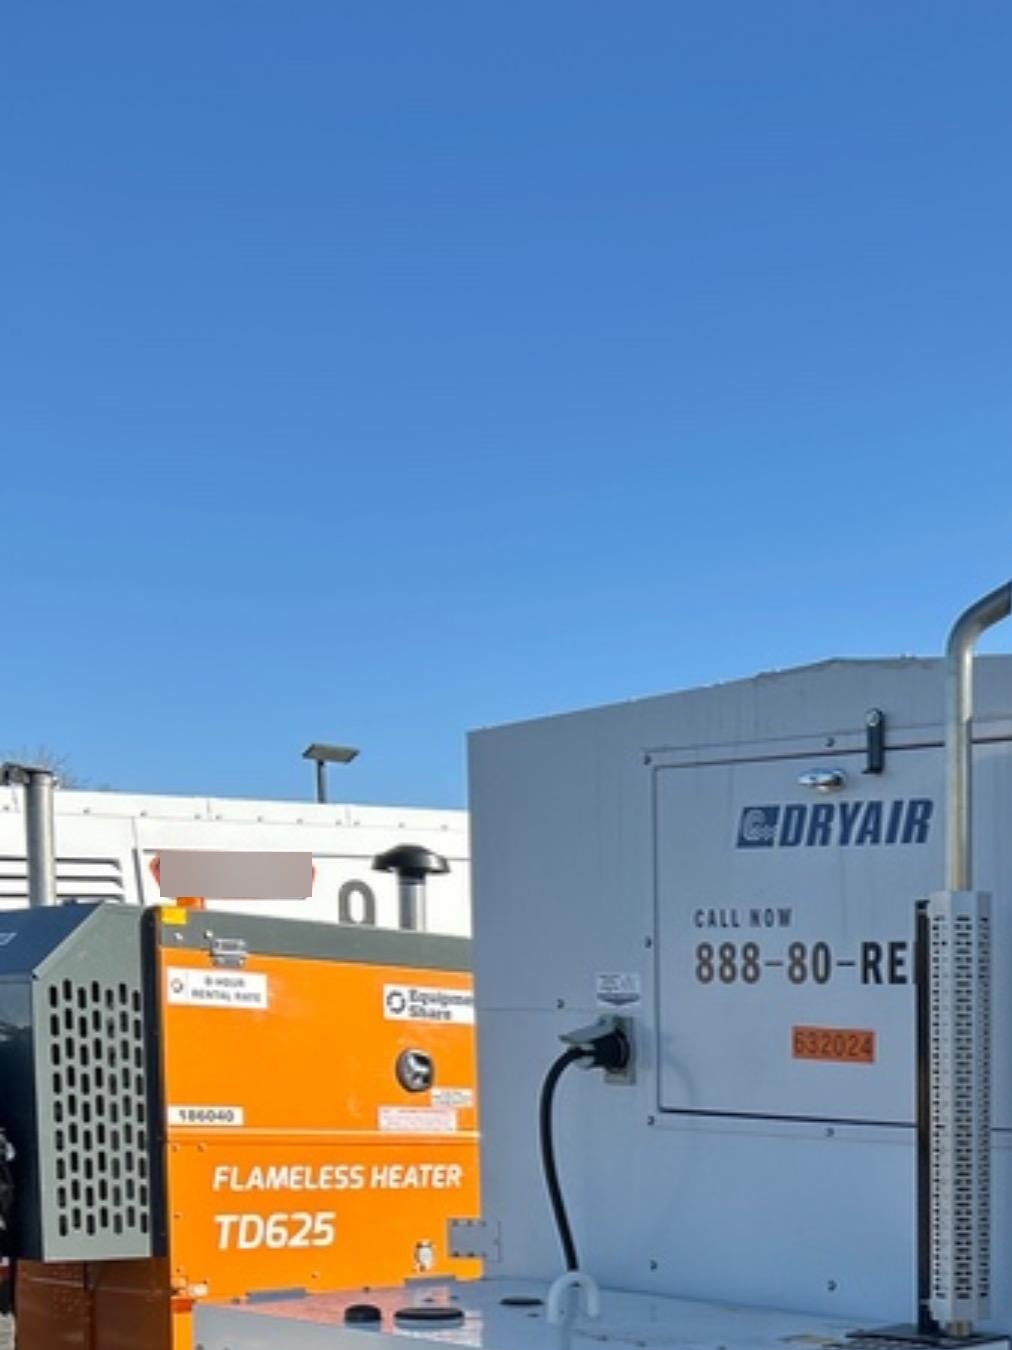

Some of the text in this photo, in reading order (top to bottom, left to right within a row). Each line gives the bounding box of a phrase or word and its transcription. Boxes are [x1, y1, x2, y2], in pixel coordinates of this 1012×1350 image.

[778, 798, 934, 848] DRYAIR
[695, 908, 793, 929] CALL NOW
[695, 940, 919, 985] 888-80-RE
[213, 1164, 463, 1191] FLAMELESS HEATER
[214, 1211, 336, 1250] TD625
